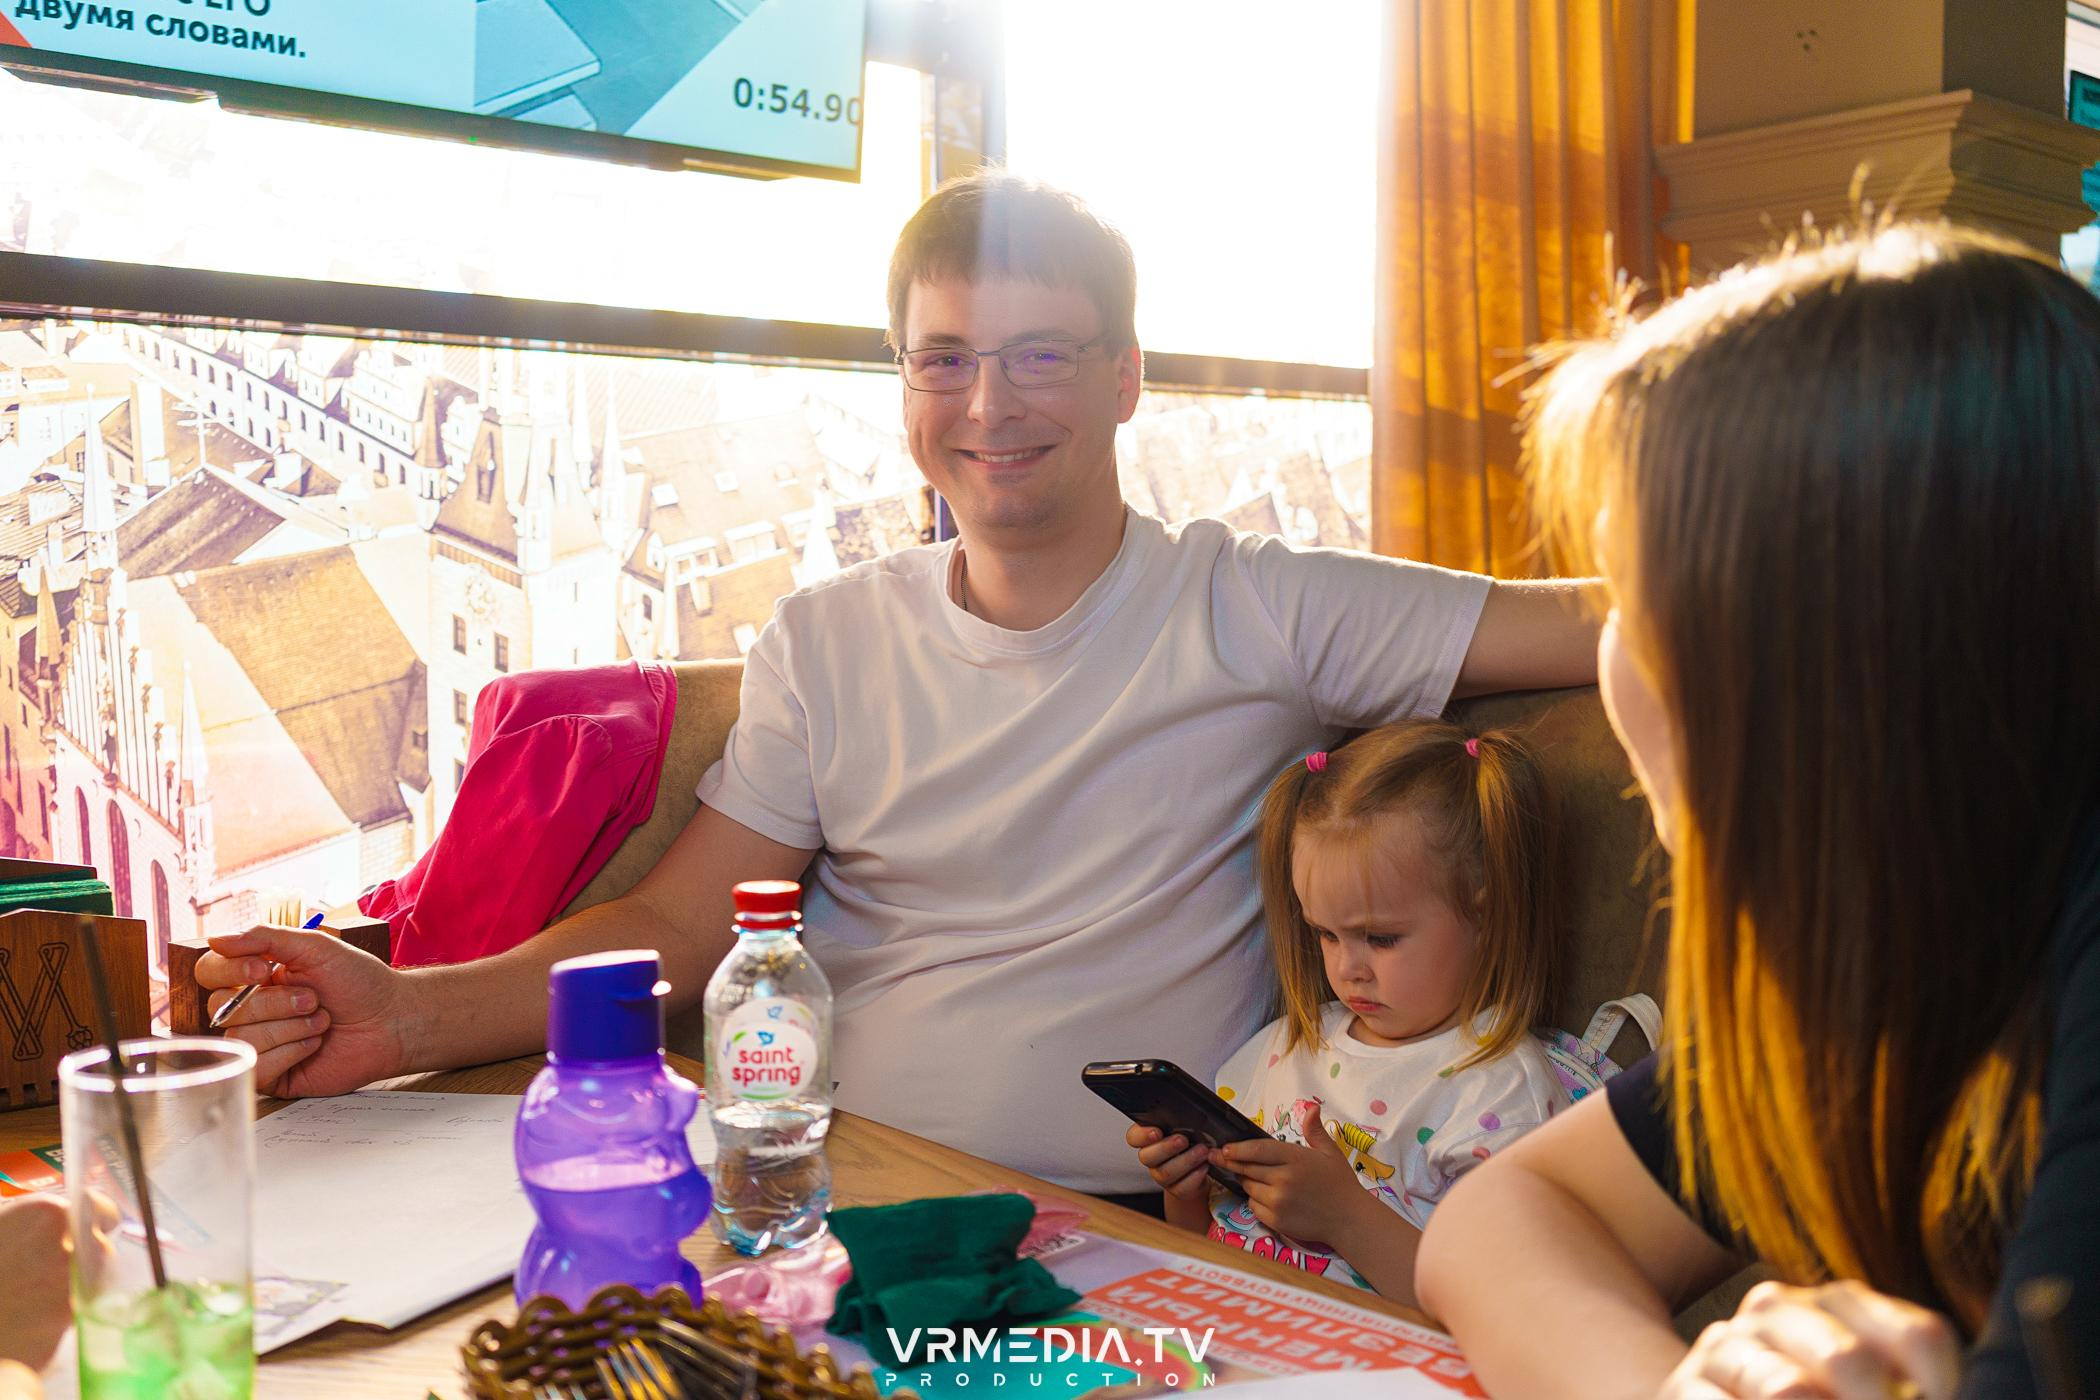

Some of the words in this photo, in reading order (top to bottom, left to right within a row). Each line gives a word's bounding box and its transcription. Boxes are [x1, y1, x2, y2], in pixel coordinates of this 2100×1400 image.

[15, 0, 135, 30] двумя
[145, 12, 306, 57] словами.
[732, 1066, 801, 1088] spring
[738, 1046, 795, 1065] saint
[1107, 1286, 1374, 1371] МЕННЫЙ
[1146, 1275, 1474, 1380] БЕЗЛИМИТ
